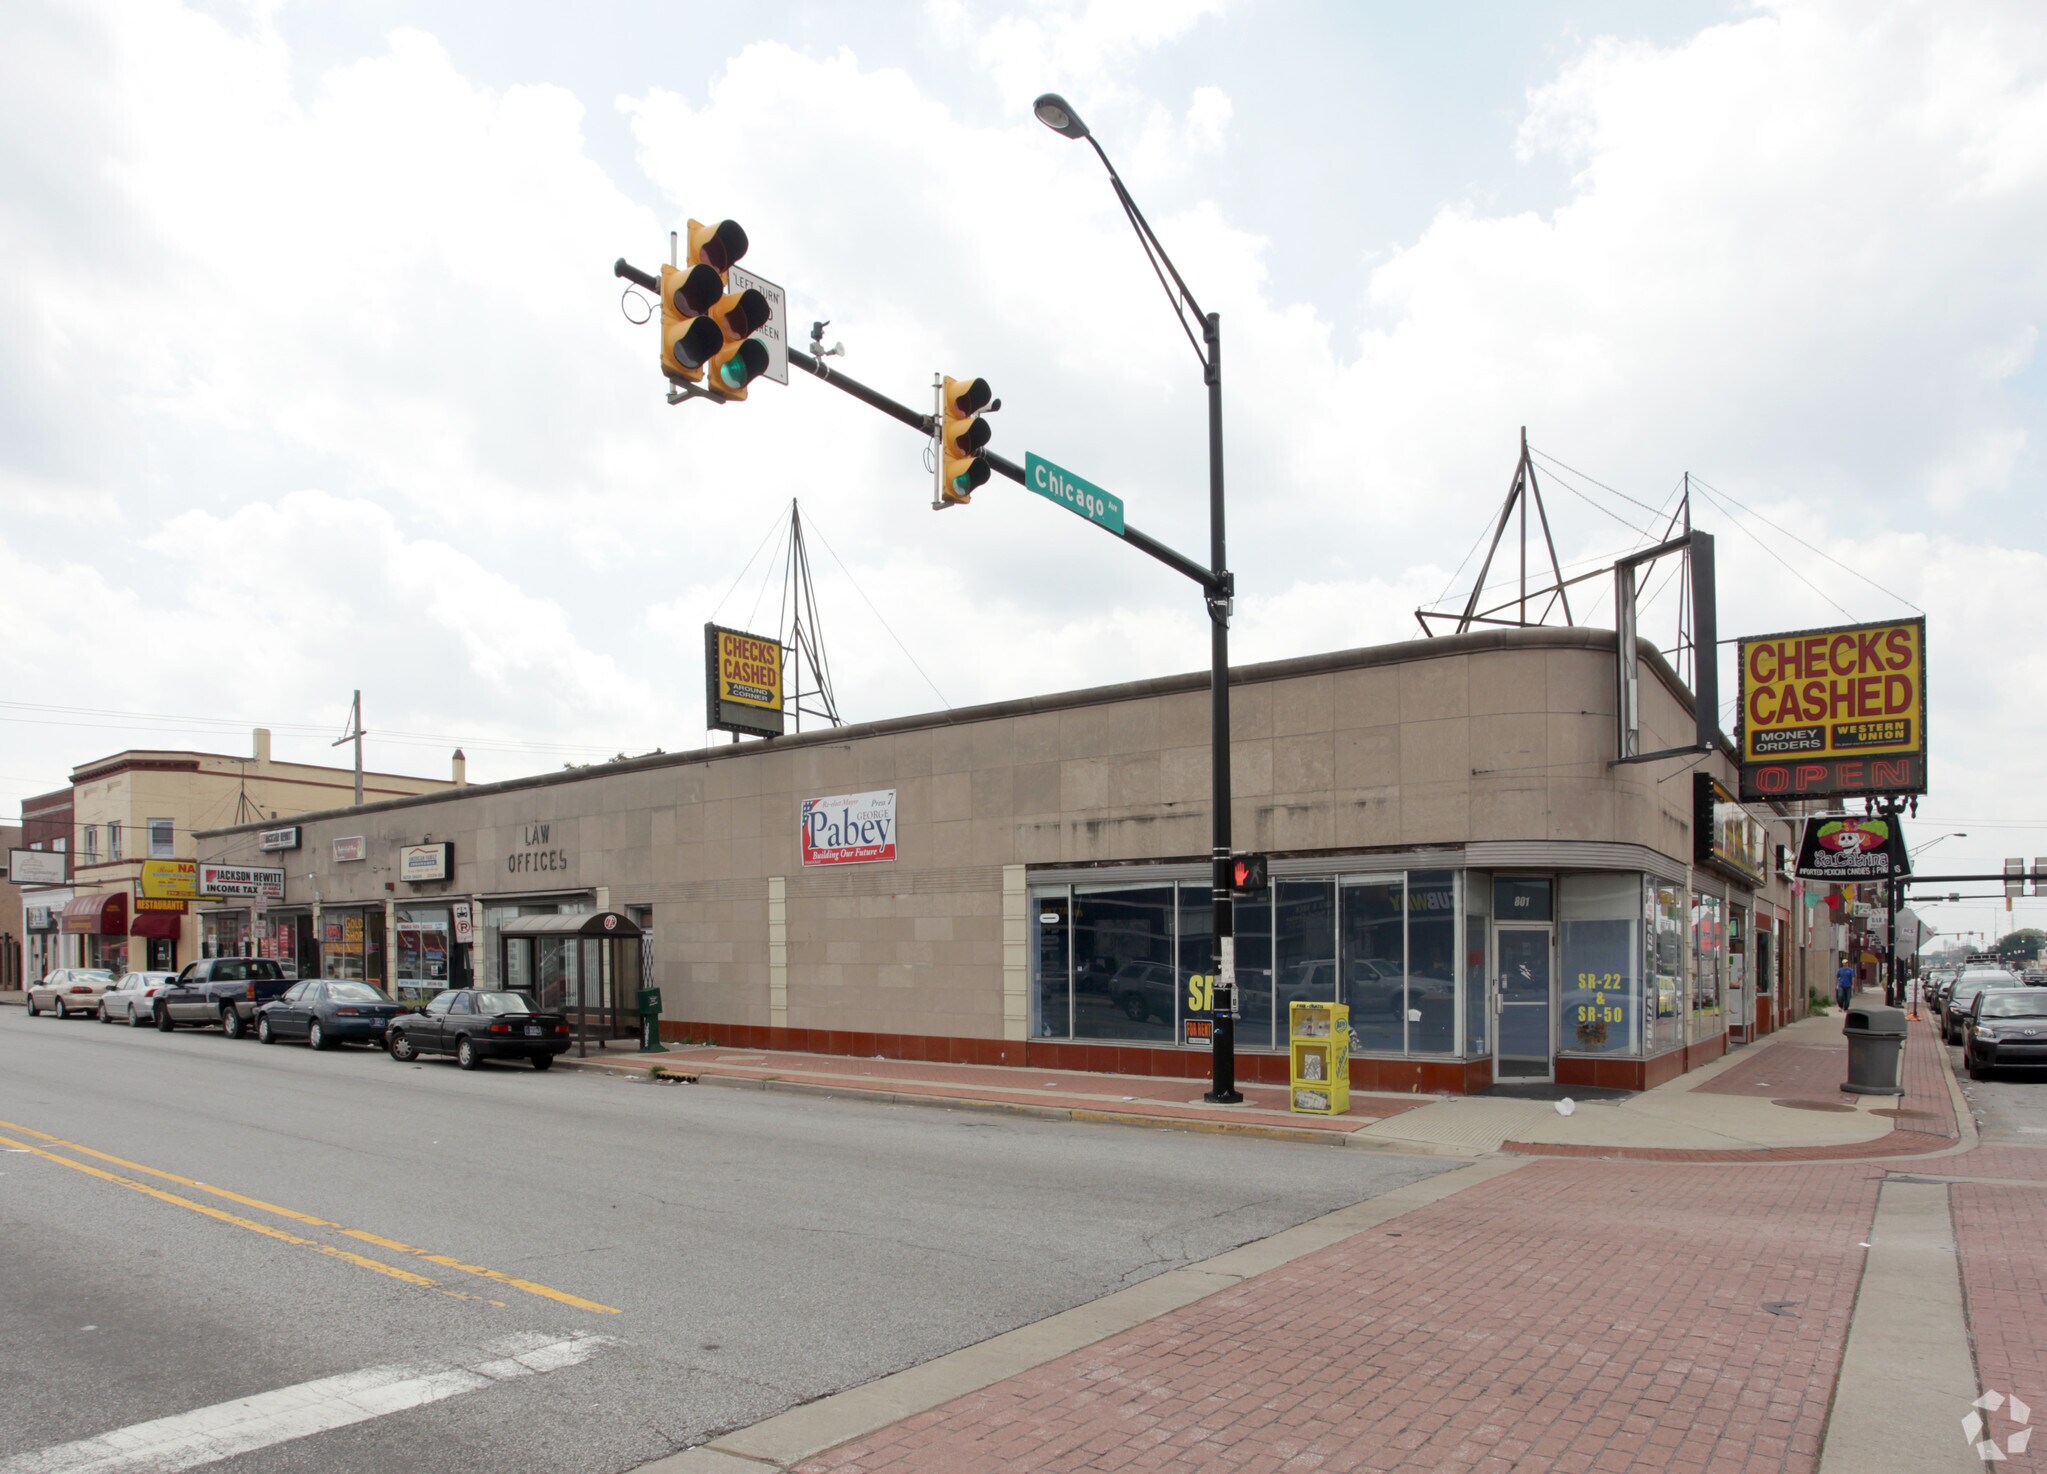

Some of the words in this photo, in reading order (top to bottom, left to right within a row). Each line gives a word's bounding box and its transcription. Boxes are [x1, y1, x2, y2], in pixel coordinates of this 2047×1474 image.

[756, 324, 780, 341] REEN
[1035, 464, 1104, 518] Chicago
[724, 635, 775, 665] CHECKS
[1750, 629, 1912, 684] CHECKS
[724, 658, 776, 687] CASHED
[732, 690, 768, 702] CORNER
[733, 683, 768, 696] AROUND
[1750, 674, 1913, 726] CASHED
[1837, 721, 1905, 735] WESTERN
[1761, 729, 1818, 742] MONEY
[1858, 730, 1904, 741] UNION
[1756, 739, 1821, 752] ORDERS
[1756, 759, 1910, 793] OPEN
[888, 792, 895, 806] 7
[857, 809, 889, 820] GEORGE
[525, 824, 550, 847] LAW
[808, 806, 892, 852] Pabey
[508, 848, 567, 873] OFFICES
[813, 850, 840, 861] Building
[840, 848, 855, 857] Our
[855, 847, 878, 857] Future
[1834, 851, 1889, 868] Catrina
[217, 869, 251, 882] JACKSON
[253, 871, 282, 883] HEWITT
[206, 884, 241, 893] INCOME
[242, 886, 259, 894] TAX
[136, 899, 185, 911] RESTAURANTE
[1514, 896, 1530, 907] 801
[346, 917, 364, 929] GOLD
[346, 930, 364, 942] SHOP
[1578, 973, 1621, 989] SR-22
[1596, 991, 1605, 1005] &
[1578, 1005, 1622, 1022] SR-50
[1186, 1022, 1197, 1036] FOR
[1198, 1022, 1211, 1038] RENT
